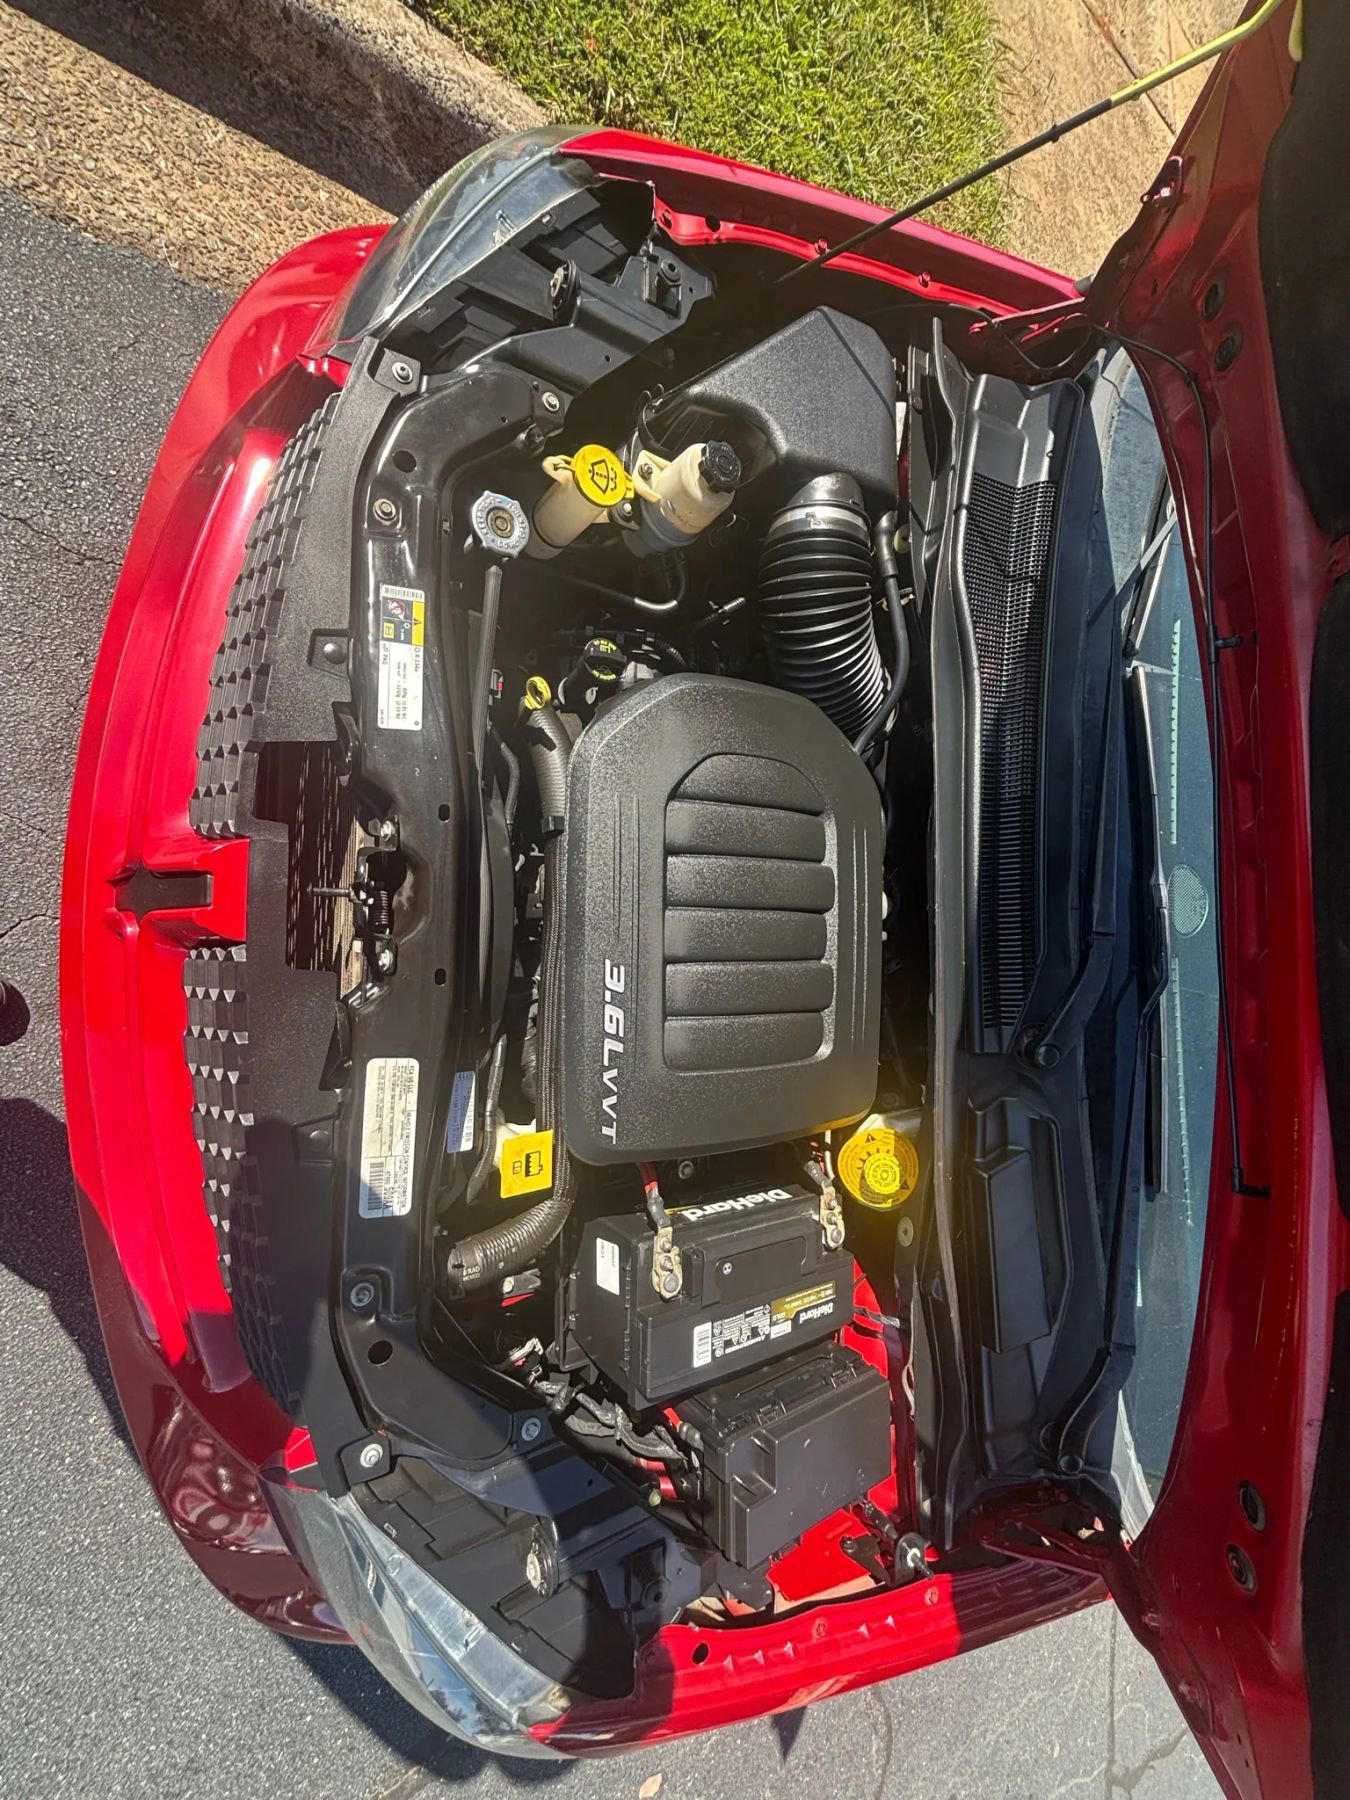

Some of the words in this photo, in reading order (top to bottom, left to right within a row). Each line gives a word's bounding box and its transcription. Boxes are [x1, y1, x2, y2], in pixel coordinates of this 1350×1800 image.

[603, 958, 625, 1067] 3.6L
[601, 1068, 618, 1145] VVT
[682, 1188, 793, 1222] DieHard
[799, 1302, 834, 1325] DieHard
